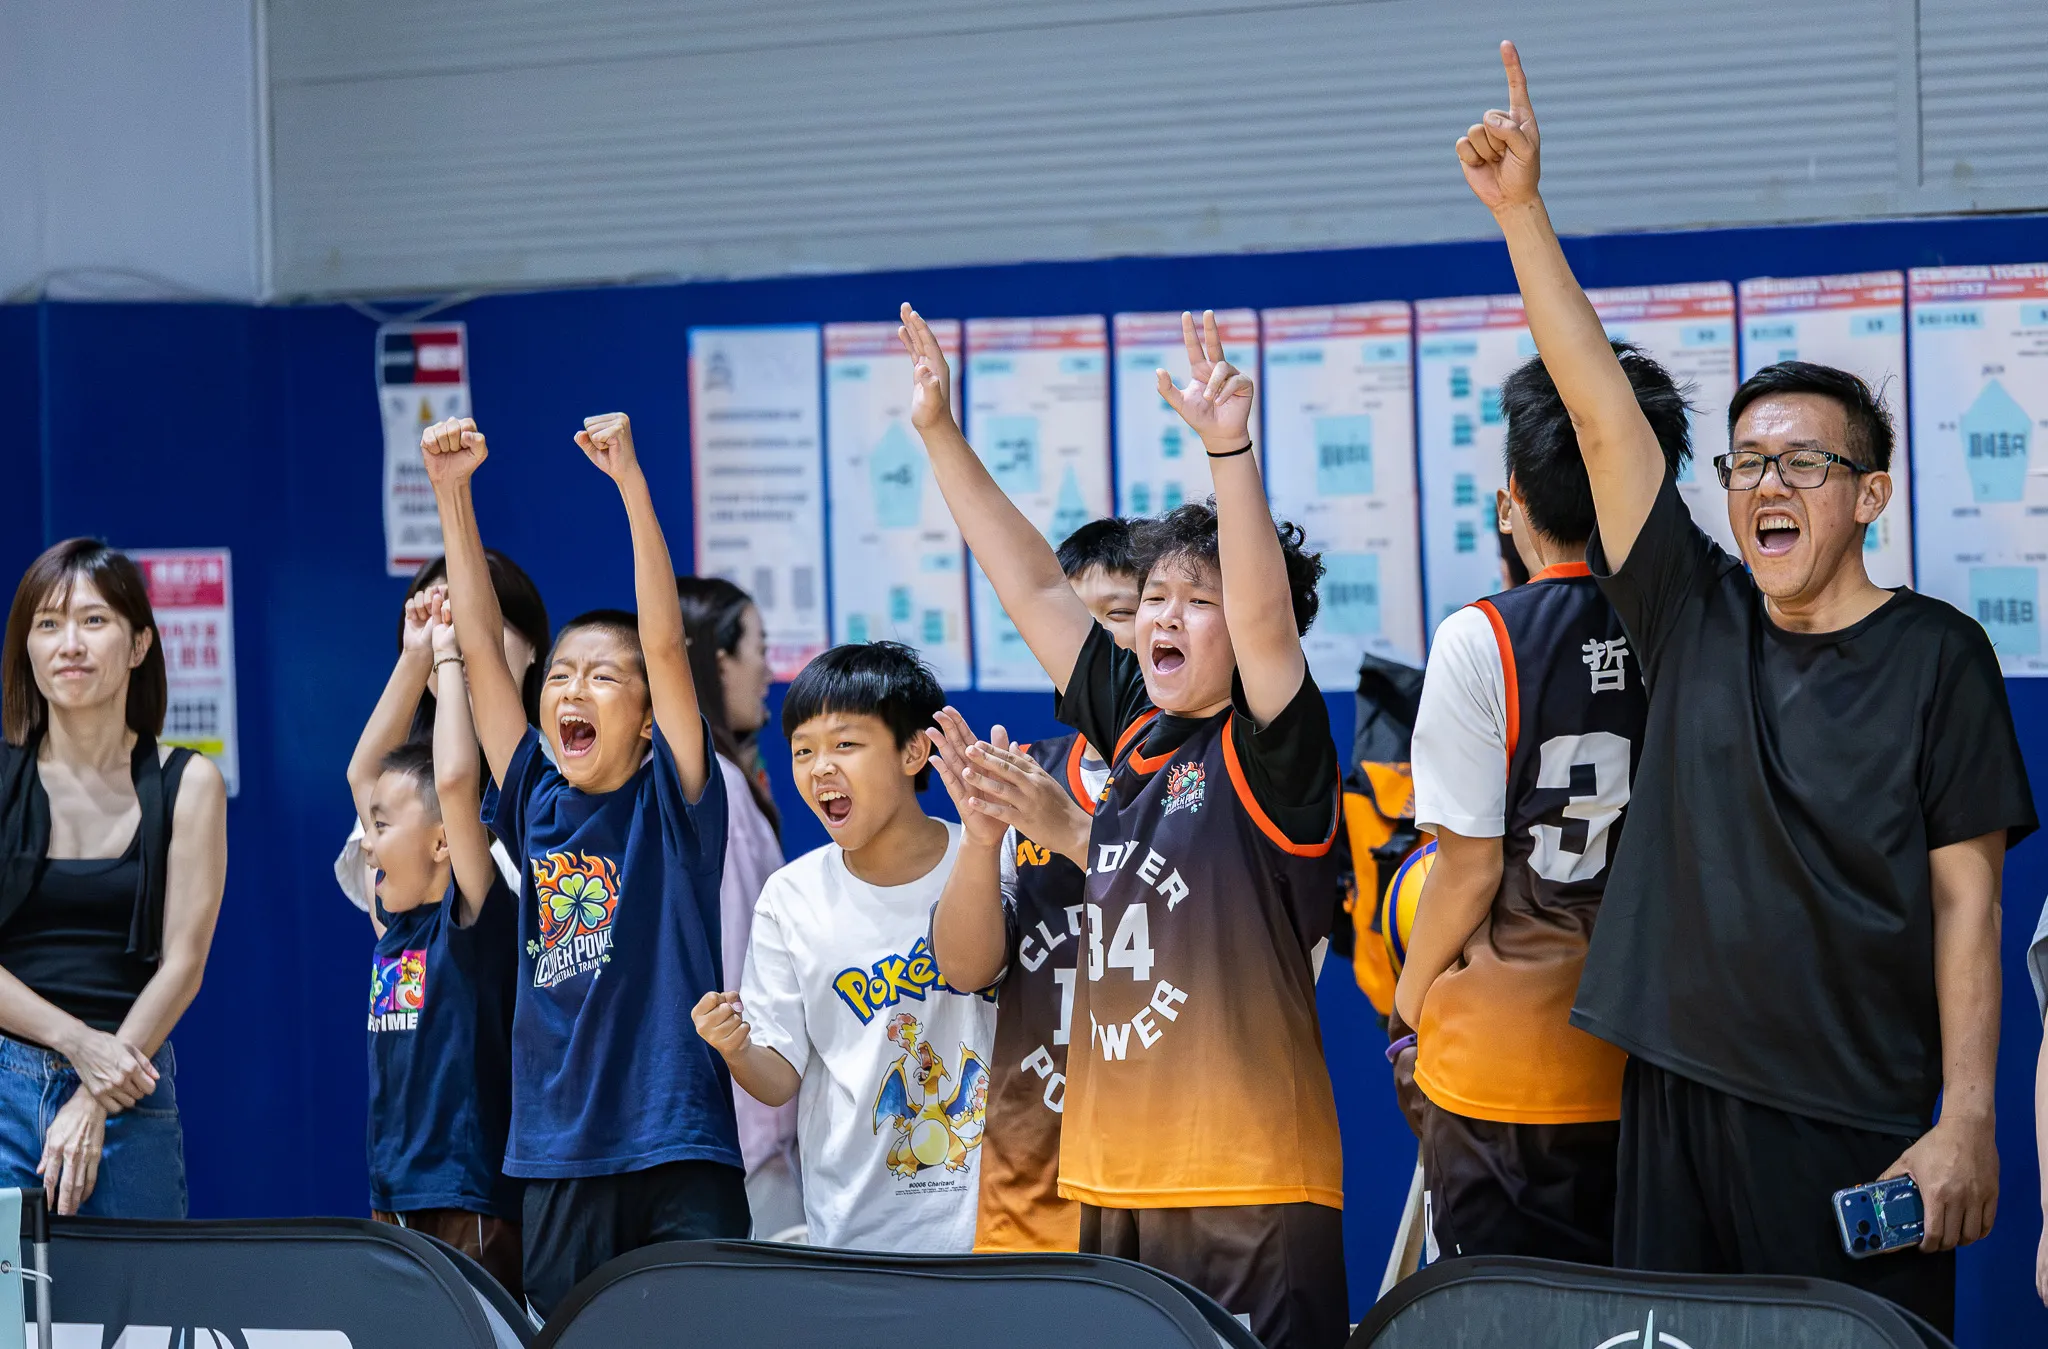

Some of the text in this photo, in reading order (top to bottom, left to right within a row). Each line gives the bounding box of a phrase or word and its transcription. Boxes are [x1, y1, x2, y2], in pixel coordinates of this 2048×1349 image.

[1582, 636, 1630, 694] 哲
[1086, 840, 1190, 912] OVER
[574, 930, 608, 964] POW
[1019, 903, 1083, 973] CLO
[832, 936, 962, 1026] Poké
[1091, 979, 1189, 1061] WER
[927, 1180, 955, 1188] Charizard
